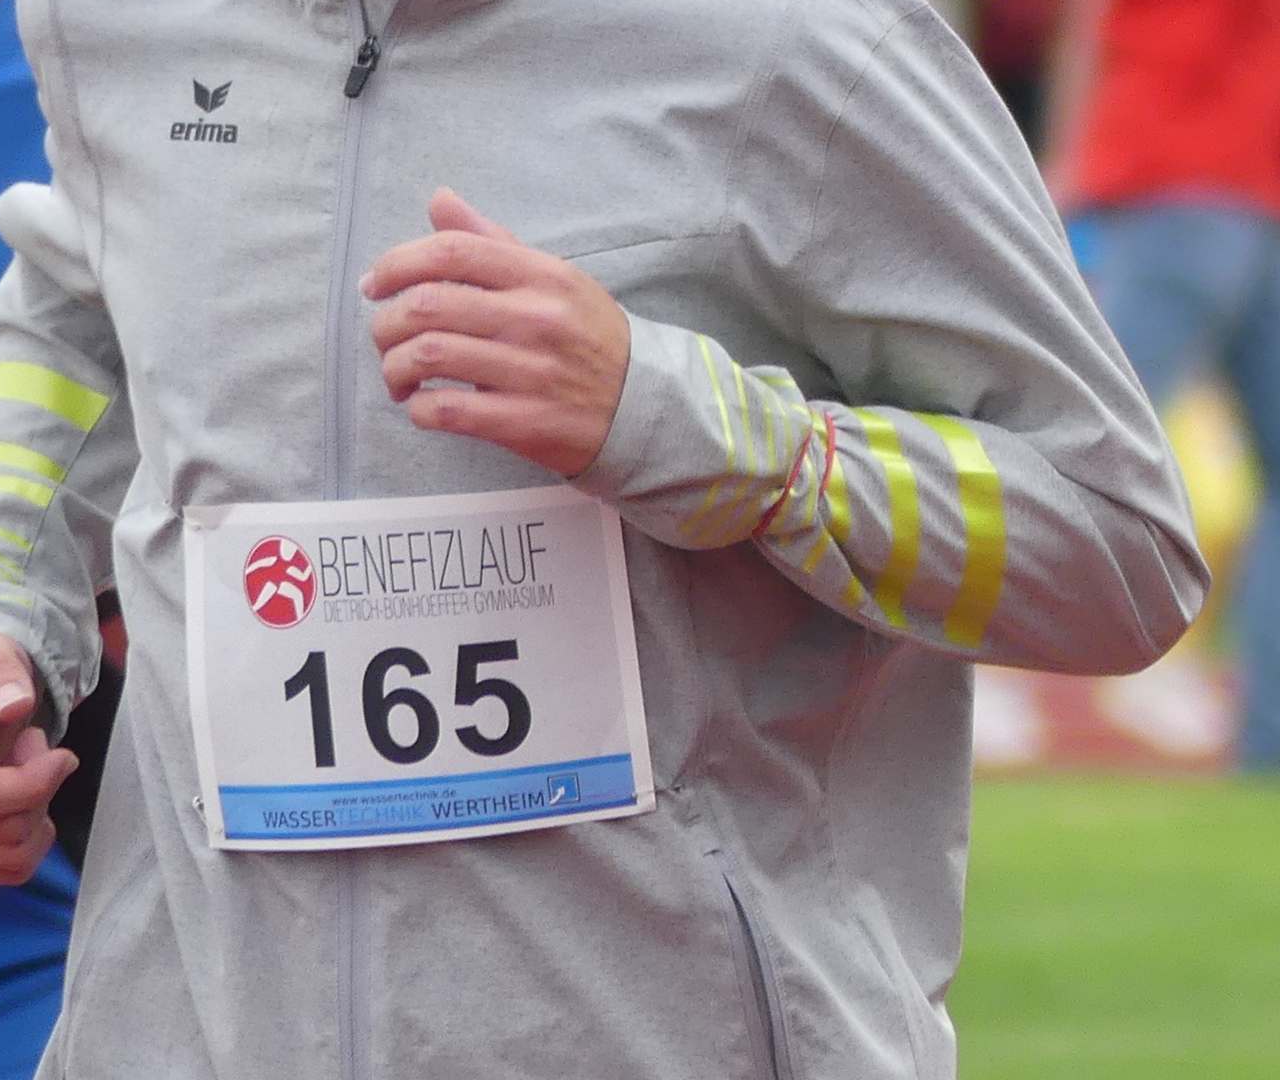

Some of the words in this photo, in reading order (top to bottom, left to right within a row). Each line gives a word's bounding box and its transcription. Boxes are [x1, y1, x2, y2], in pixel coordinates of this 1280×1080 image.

[170, 118, 238, 144] erima
[318, 522, 547, 597] BENEFIZLAUF
[284, 639, 532, 768] 165
[431, 791, 545, 820] WERTHEIM
